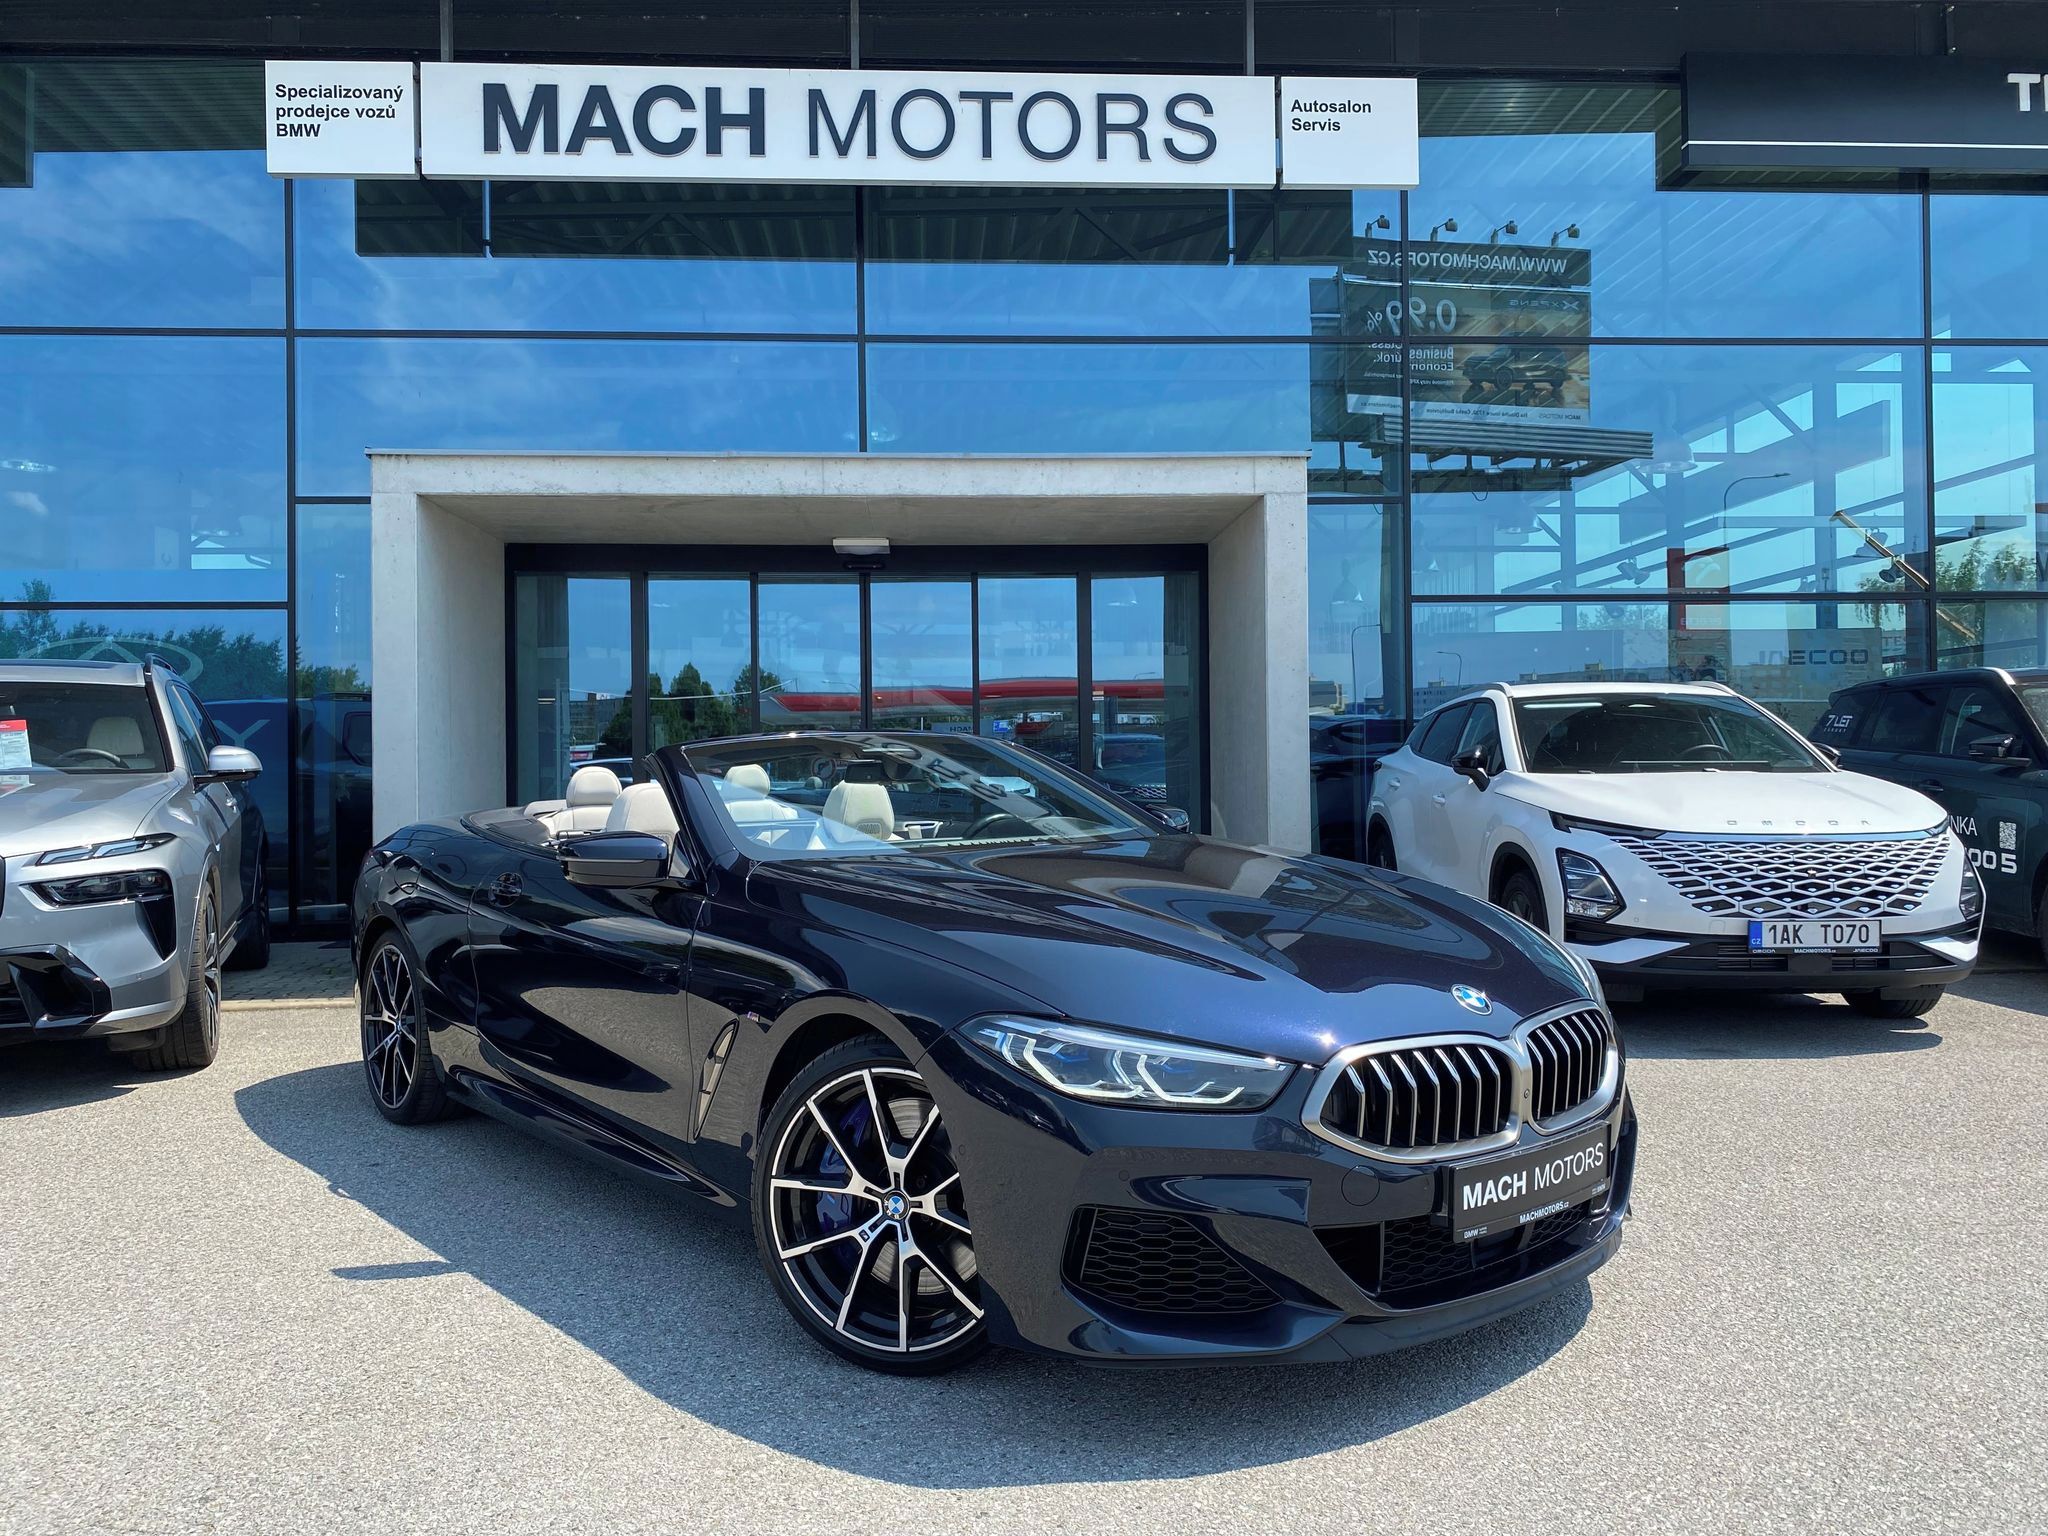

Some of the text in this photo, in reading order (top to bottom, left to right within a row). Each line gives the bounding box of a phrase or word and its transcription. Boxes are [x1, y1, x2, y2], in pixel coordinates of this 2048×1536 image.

[275, 83, 404, 102] Specializovaný
[2007, 72, 2048, 112] T
[275, 102, 396, 122] prodejce vozů
[1290, 98, 1373, 115] Autosalon
[276, 122, 321, 138] BMW
[482, 83, 1219, 164] MACH MOTORS
[1291, 117, 1342, 133] Servis
[1948, 814, 1978, 837] NKA
[2000, 853, 2018, 874] 5
[1768, 924, 1804, 945] 1AK
[1820, 923, 1870, 944] T070
[1463, 1142, 1604, 1211] MACH MOTORS
